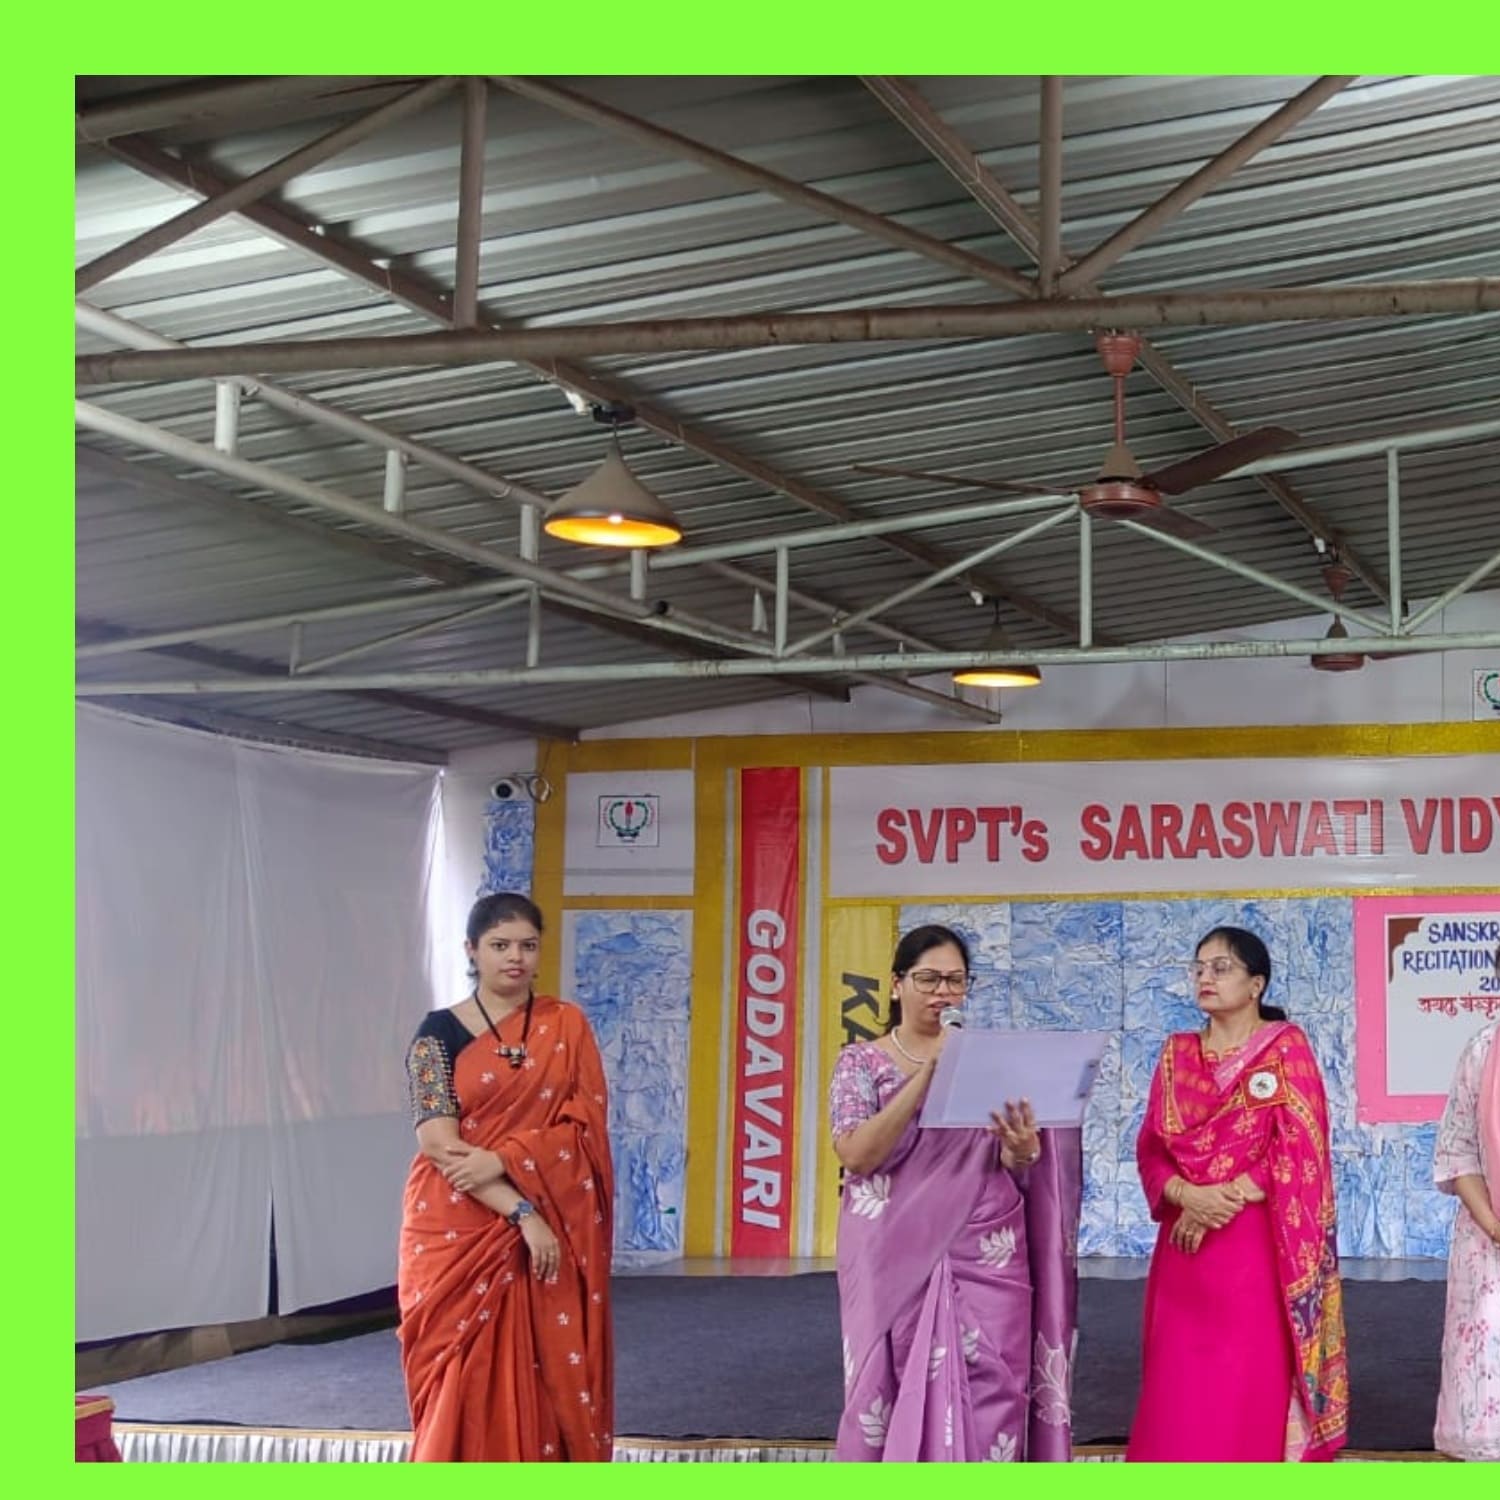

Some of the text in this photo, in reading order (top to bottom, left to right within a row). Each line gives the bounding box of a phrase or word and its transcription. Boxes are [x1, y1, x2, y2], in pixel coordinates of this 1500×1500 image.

[877, 807, 1049, 864] SVPT's
[1081, 801, 1384, 860] SARASWATI
[1402, 947, 1500, 975] RECITATION
[742, 908, 788, 1230] GODAVARI
